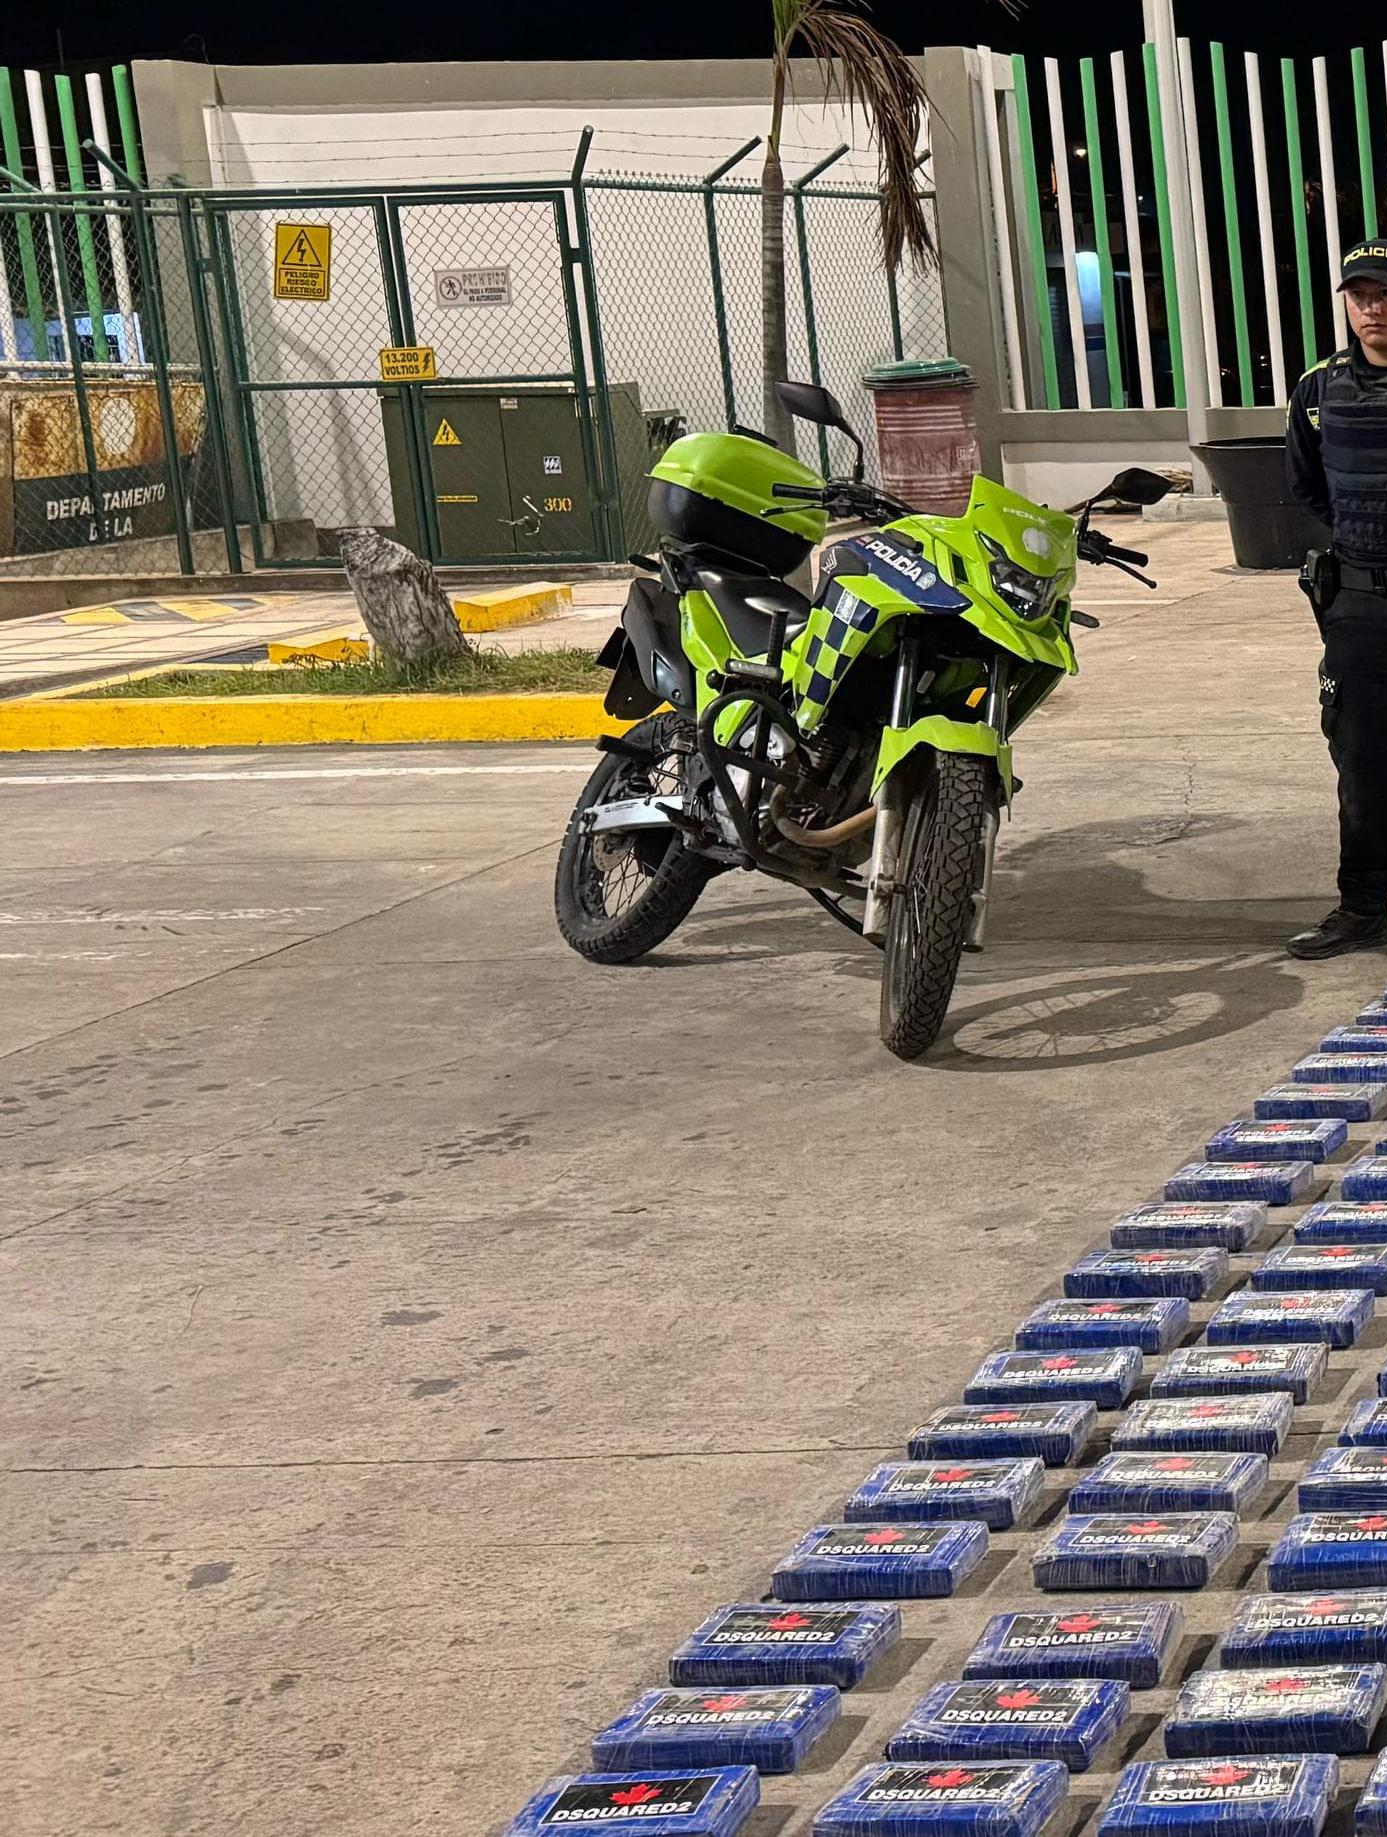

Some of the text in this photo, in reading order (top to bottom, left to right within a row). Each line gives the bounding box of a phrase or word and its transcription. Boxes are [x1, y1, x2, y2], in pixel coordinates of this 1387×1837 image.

[285, 271, 319, 279] PELIGRO
[385, 352, 418, 364] 13.200
[385, 364, 419, 376] VOLTIOS
[46, 483, 165, 520] DEPATAMENTO
[544, 497, 572, 512] 300
[114, 516, 133, 537] LA
[865, 539, 923, 581] POLICÍA
[1101, 1260, 1189, 1268] DSQUARED2
[1285, 1255, 1375, 1264] DSQUARED2
[1003, 1367, 1104, 1378] DSQUARED2
[939, 1422, 1043, 1431] DSQUARED2
[891, 1481, 996, 1491] DSQUARED2
[1080, 1534, 1191, 1545] DSQUARED2
[817, 1545, 930, 1554] DSQUARED2
[1255, 1612, 1378, 1628] DSQUARED2
[714, 1631, 835, 1643] DSQUARED2
[1009, 1632, 1134, 1647] DSQUARED2
[648, 1712, 776, 1725] DSQUARED2
[942, 1710, 1067, 1722] DSQUARED2
[867, 1789, 999, 1800] DSQUARED2
[1149, 1783, 1285, 1801] DSQUARED2
[552, 1801, 692, 1821] DSQUARED2
